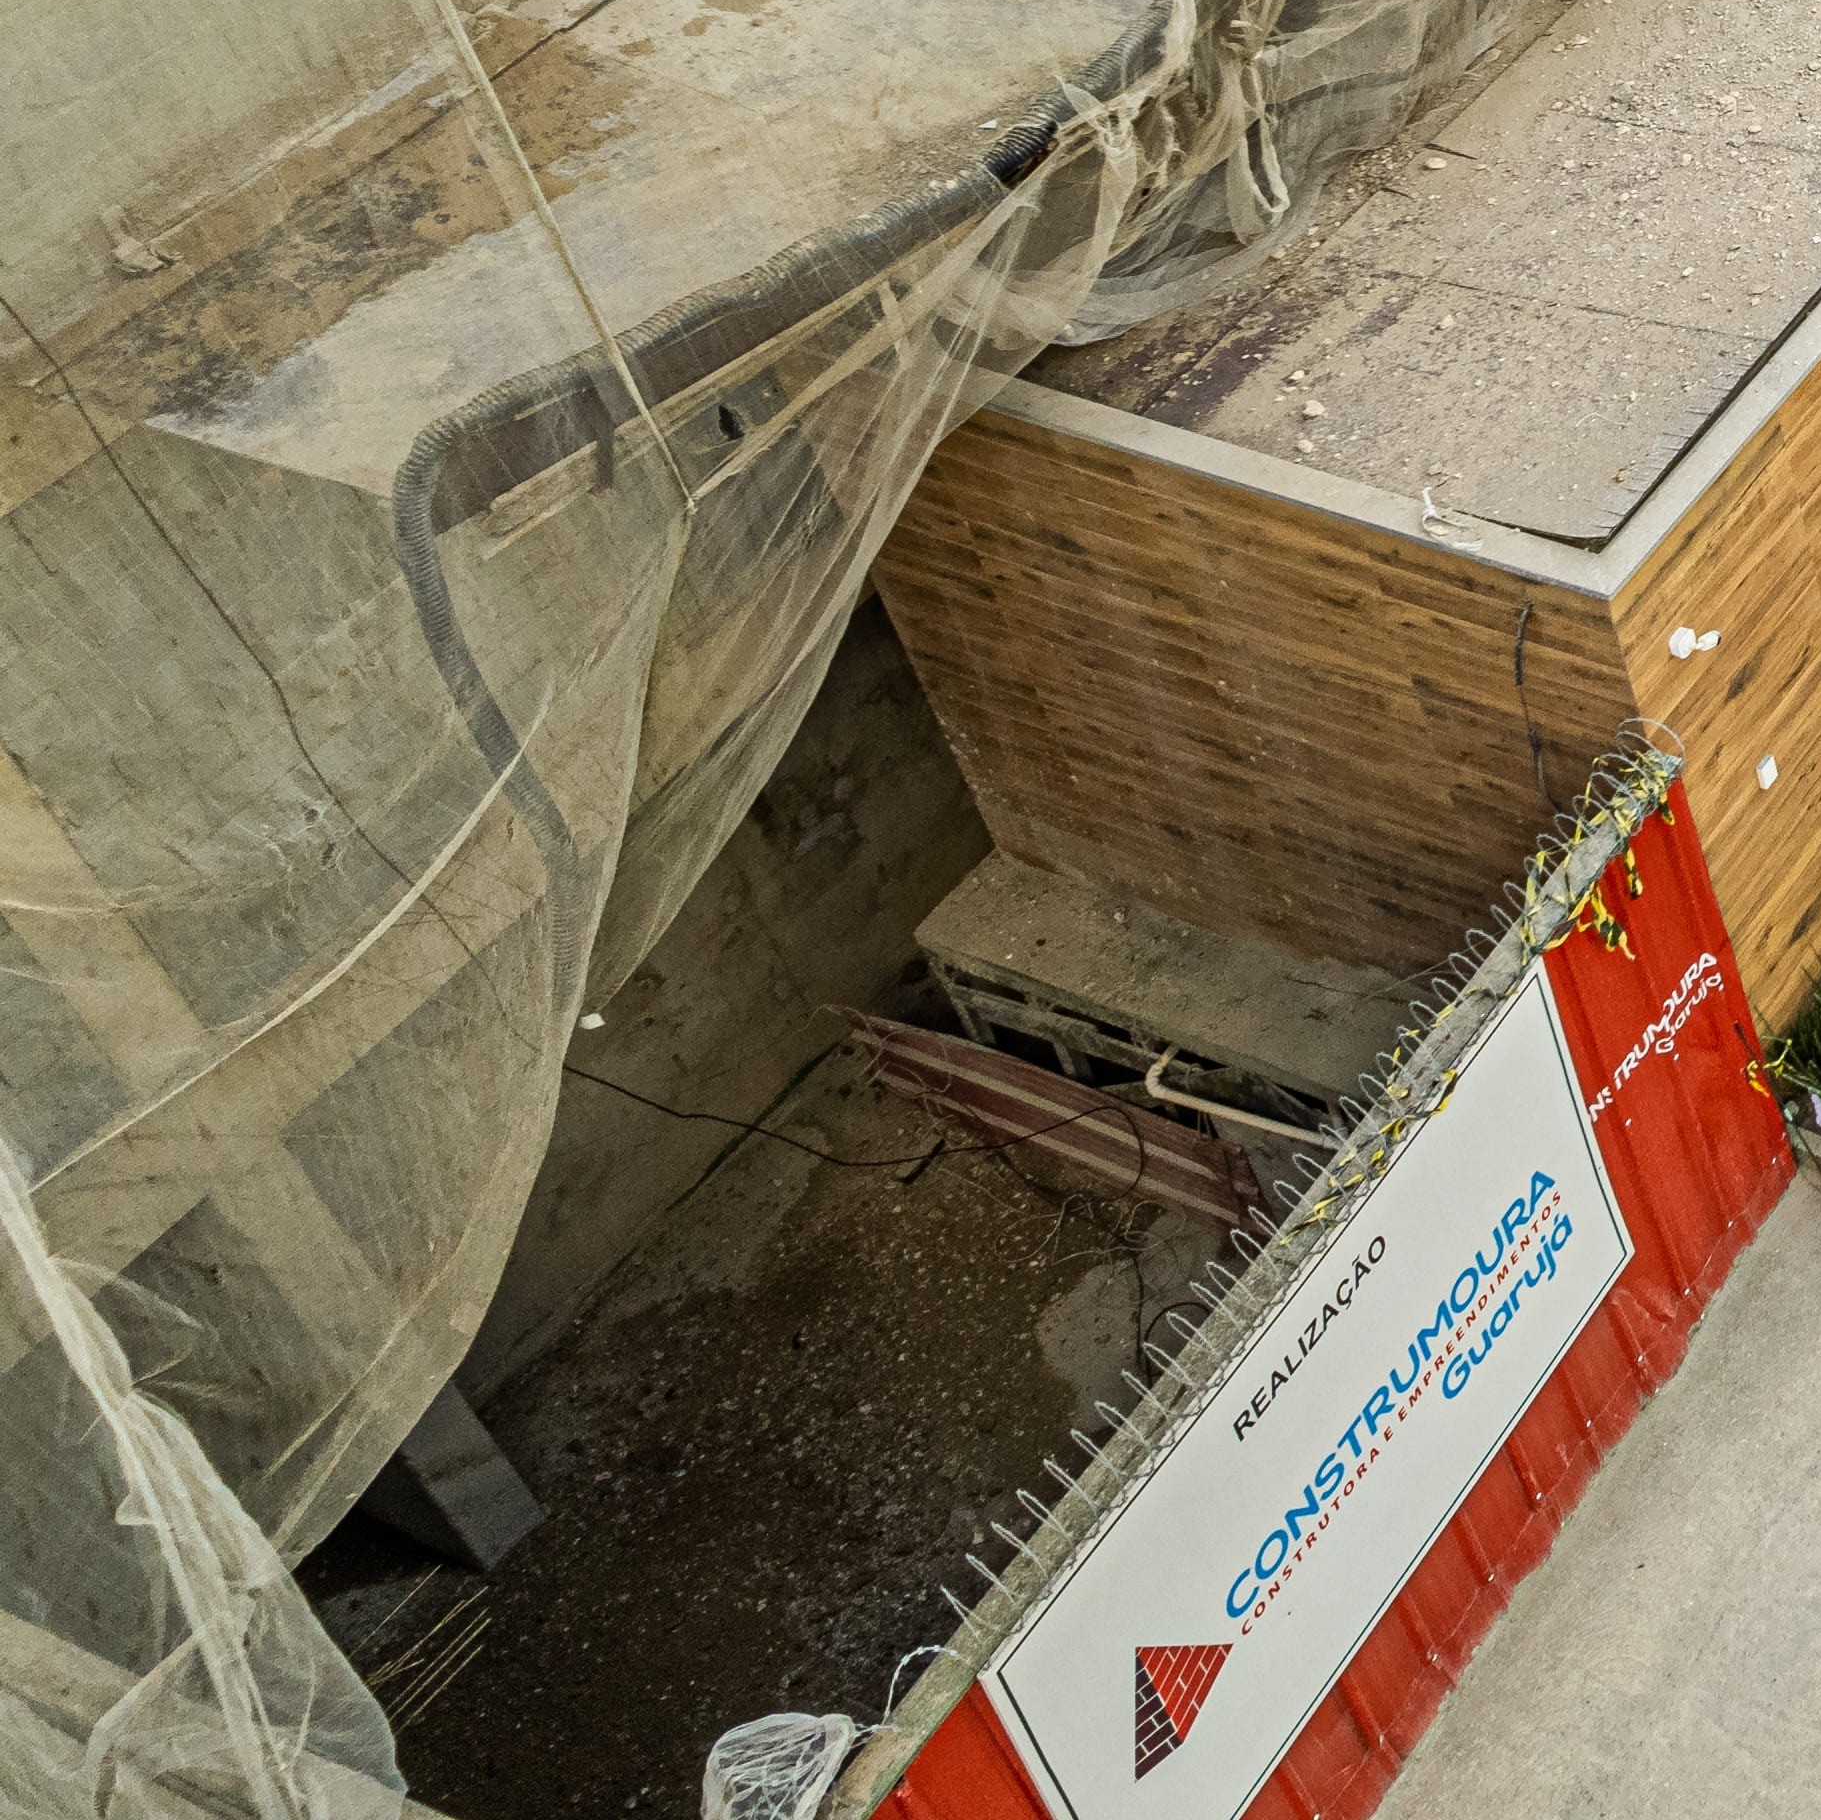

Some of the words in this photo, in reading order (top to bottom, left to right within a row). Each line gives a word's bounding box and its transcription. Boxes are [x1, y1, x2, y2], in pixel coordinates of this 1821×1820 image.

[1225, 1170, 1556, 1620] CONSTRUMOURA
[1233, 1234, 1388, 1442] REALIZAÇÃO
[1241, 1447, 1379, 1635] CONSTRUTORA
[1383, 1426, 1392, 1441] E
[1397, 1193, 1561, 1421] EMPREENDIMENTOS
[1441, 1214, 1573, 1400] Guarujá
